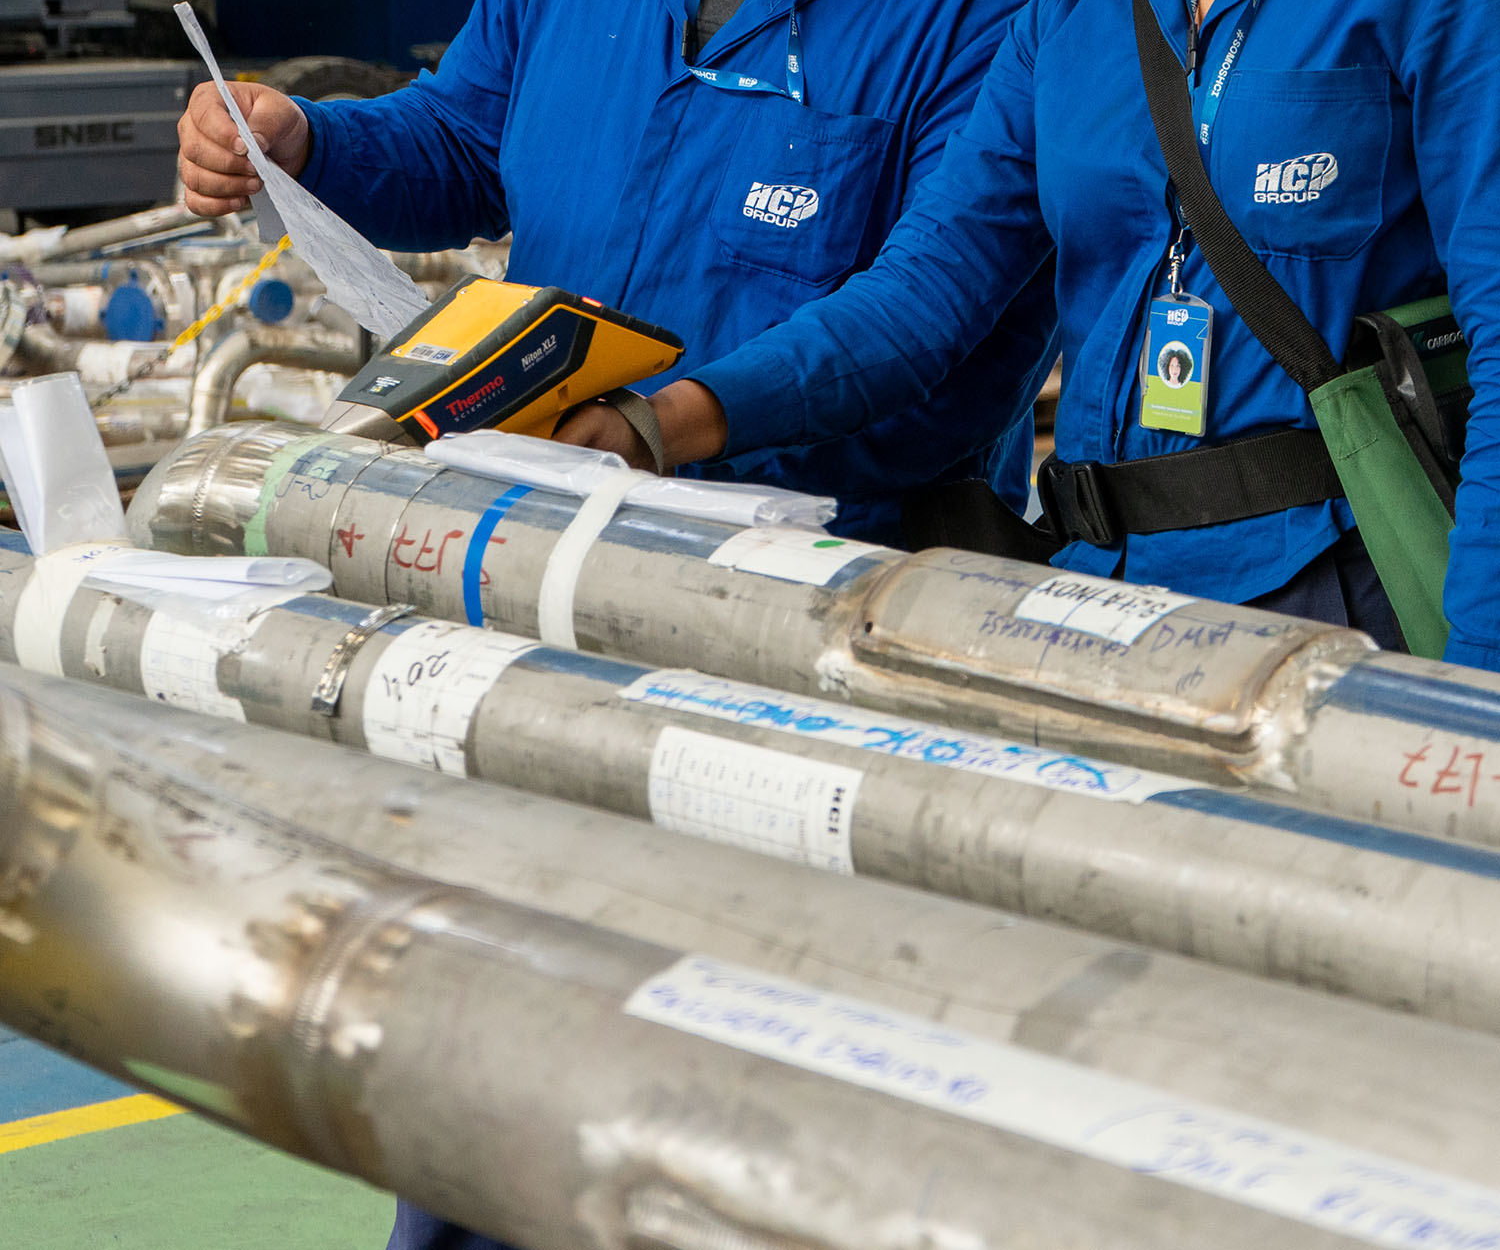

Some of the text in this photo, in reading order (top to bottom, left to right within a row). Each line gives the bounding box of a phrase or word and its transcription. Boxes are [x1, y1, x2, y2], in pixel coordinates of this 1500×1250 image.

[1211, 29, 1245, 98] #SOMOSHCI
[1255, 153, 1338, 192] HCI
[744, 181, 819, 221] HCI
[1254, 191, 1320, 204] GROUP
[742, 206, 799, 229] GROUP
[521, 347, 543, 368] Niton
[541, 334, 556, 352] XL2
[445, 375, 504, 416] Thermo
[454, 385, 506, 422] SCIENTIFIC
